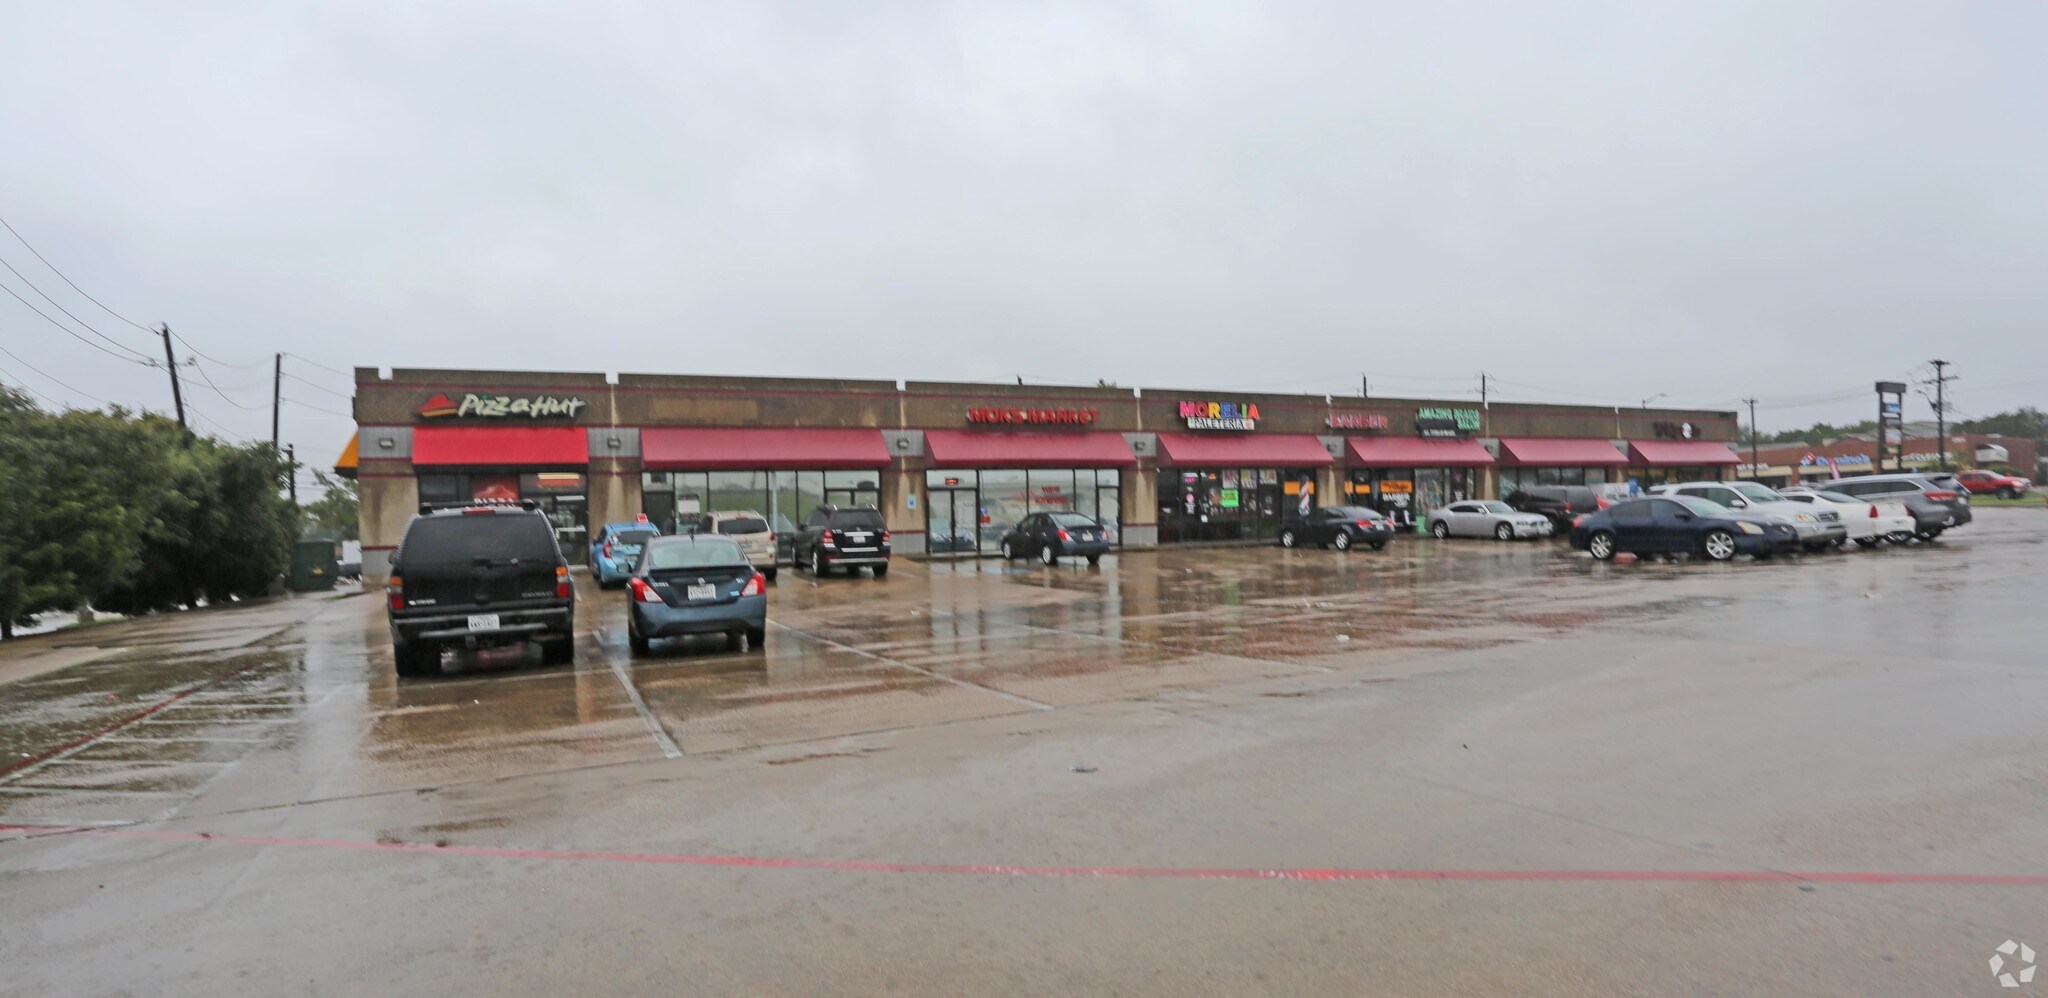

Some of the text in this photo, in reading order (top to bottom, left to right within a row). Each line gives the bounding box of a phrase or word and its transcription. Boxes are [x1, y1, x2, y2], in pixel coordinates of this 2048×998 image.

[457, 393, 586, 418] Pizza Hut
[1027, 405, 1098, 425] MARKET
[1180, 401, 1260, 420] MORELIA
[1329, 413, 1388, 429] BARBER
